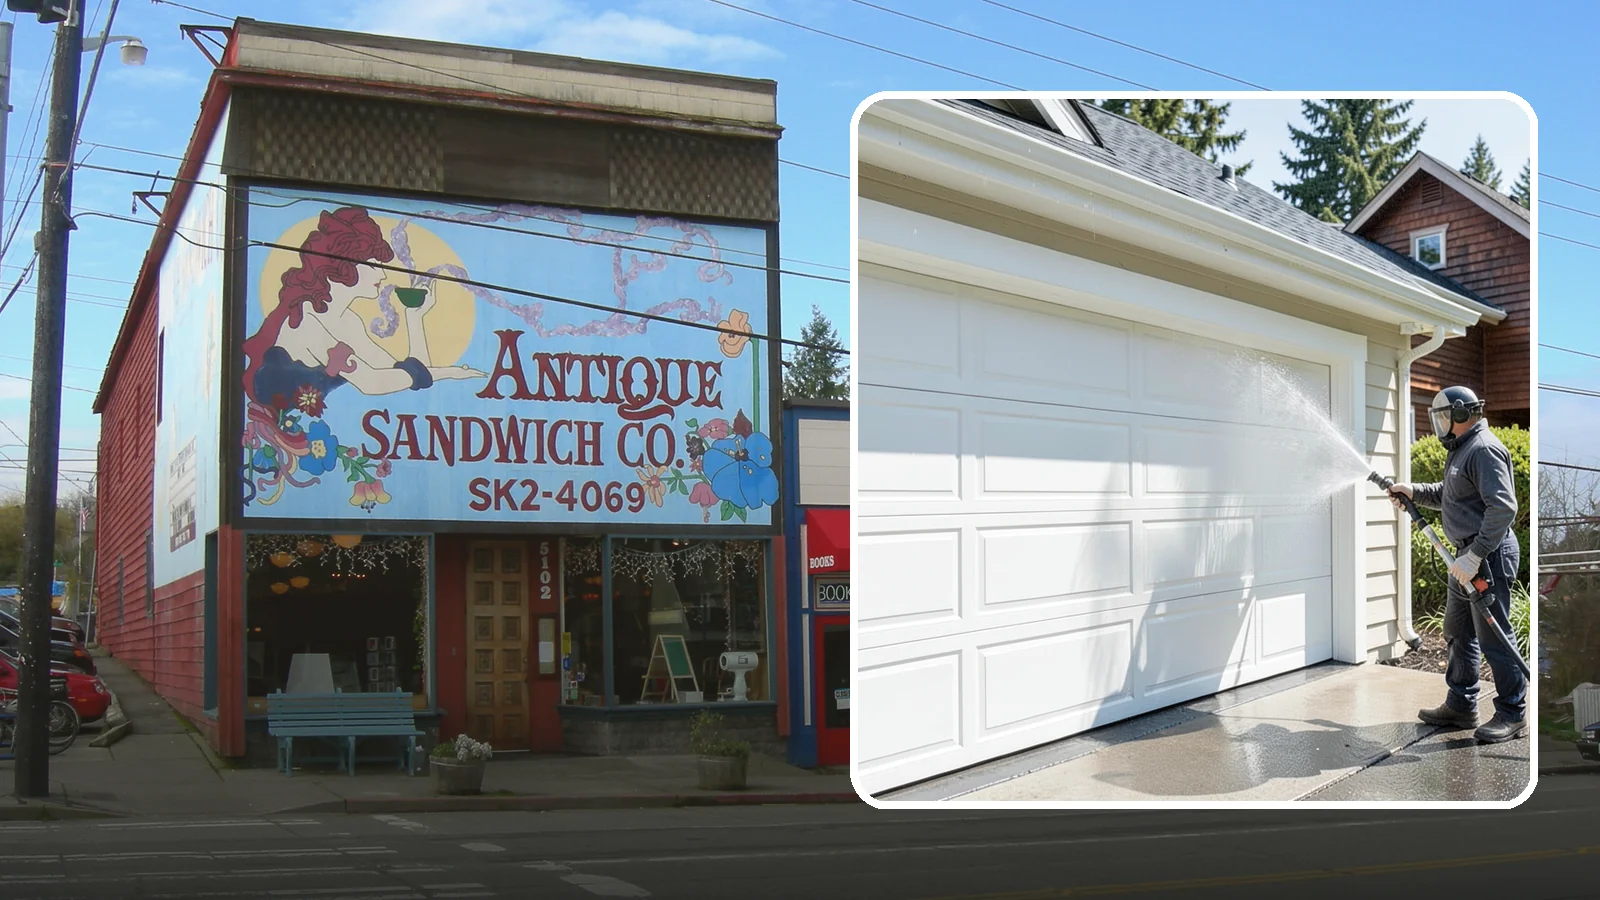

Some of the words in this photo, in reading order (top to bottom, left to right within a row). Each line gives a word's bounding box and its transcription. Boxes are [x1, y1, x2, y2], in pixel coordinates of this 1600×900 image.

[475, 329, 724, 421] ANTIQUE
[361, 408, 605, 467] SANDWICH
[617, 421, 685, 468] CO.
[468, 476, 646, 513] SK2-4069
[540, 541, 552, 600] 5102
[809, 555, 835, 569] BOOKS
